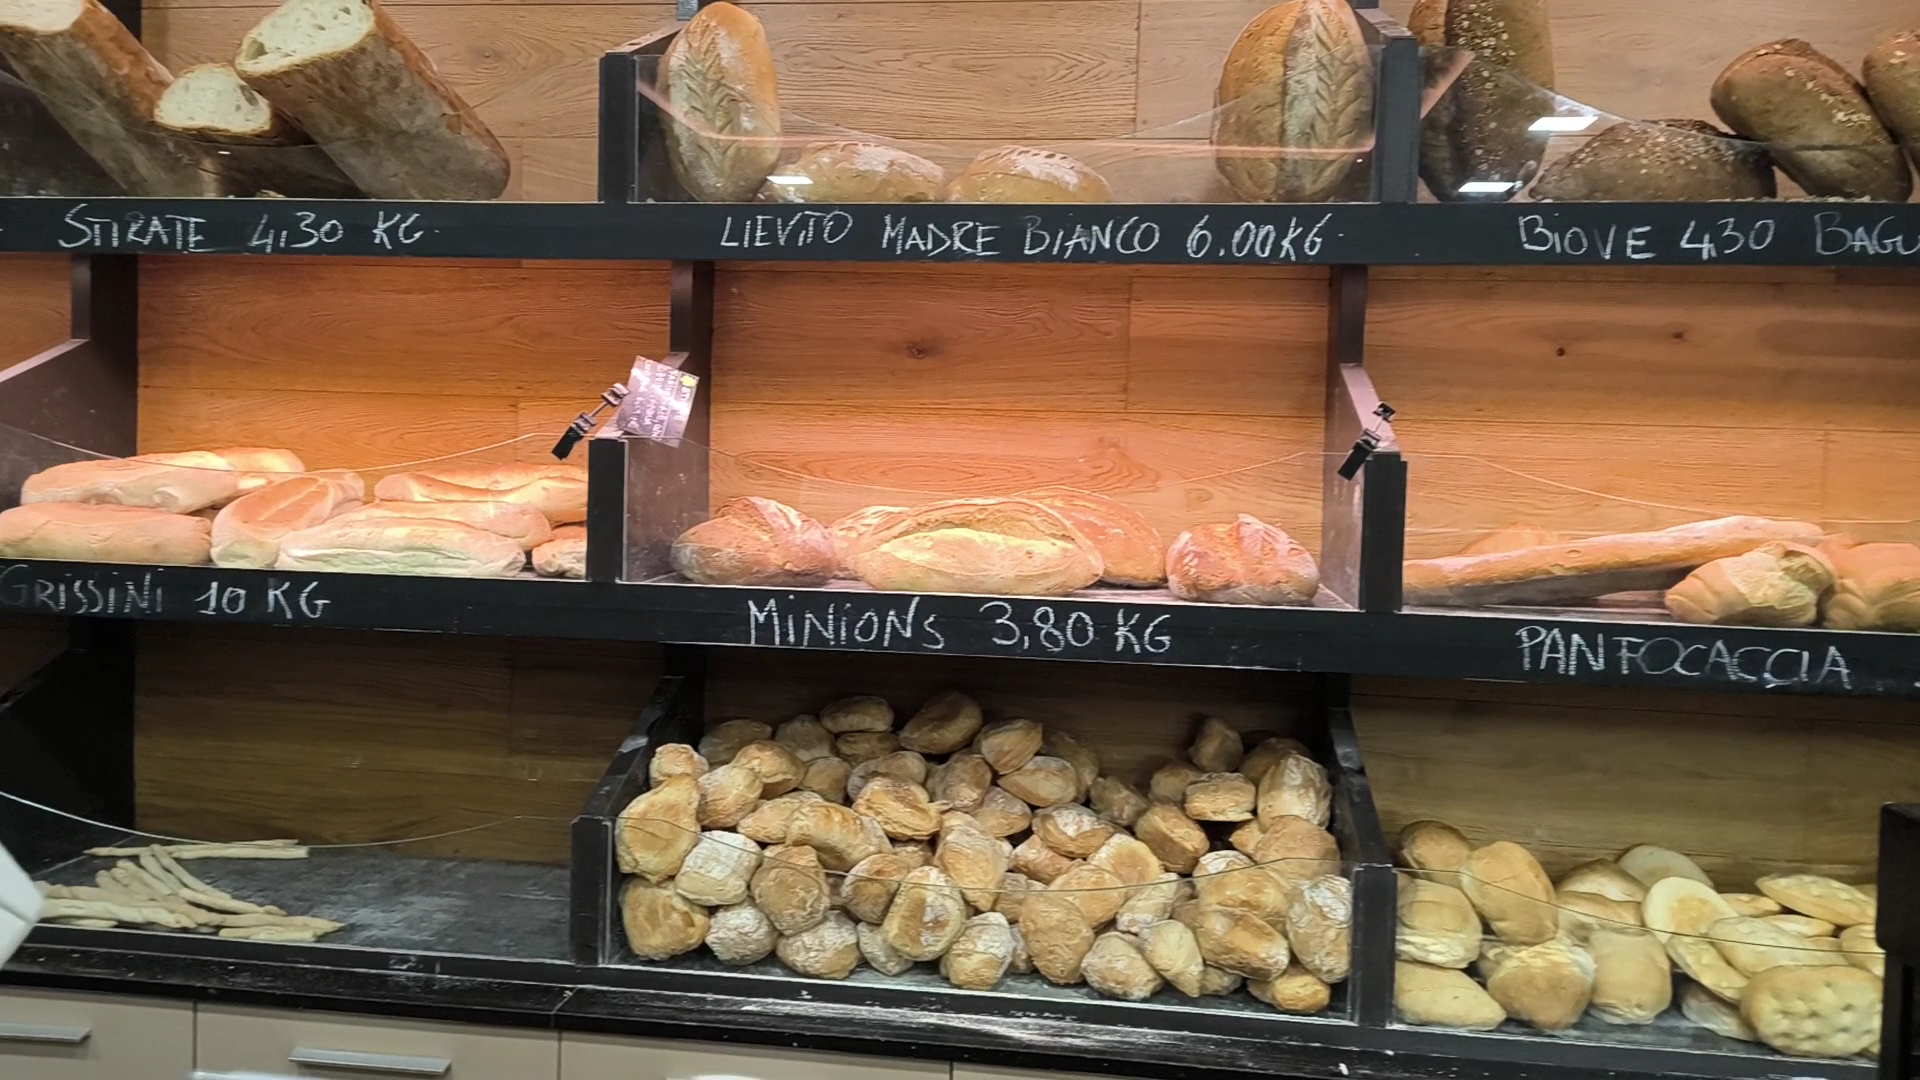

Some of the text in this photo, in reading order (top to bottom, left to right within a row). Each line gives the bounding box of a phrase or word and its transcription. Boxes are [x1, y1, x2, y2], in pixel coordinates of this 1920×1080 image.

[57, 203, 208, 252] STIRATE
[720, 210, 853, 248] LIEVITO
[881, 213, 1001, 256] MADRE
[194, 581, 247, 615] 10
[267, 579, 331, 619] KG
[978, 601, 1095, 653] 3,80
[1115, 608, 1171, 654] KG
[1515, 625, 1853, 690] PAN FOCACCIA
